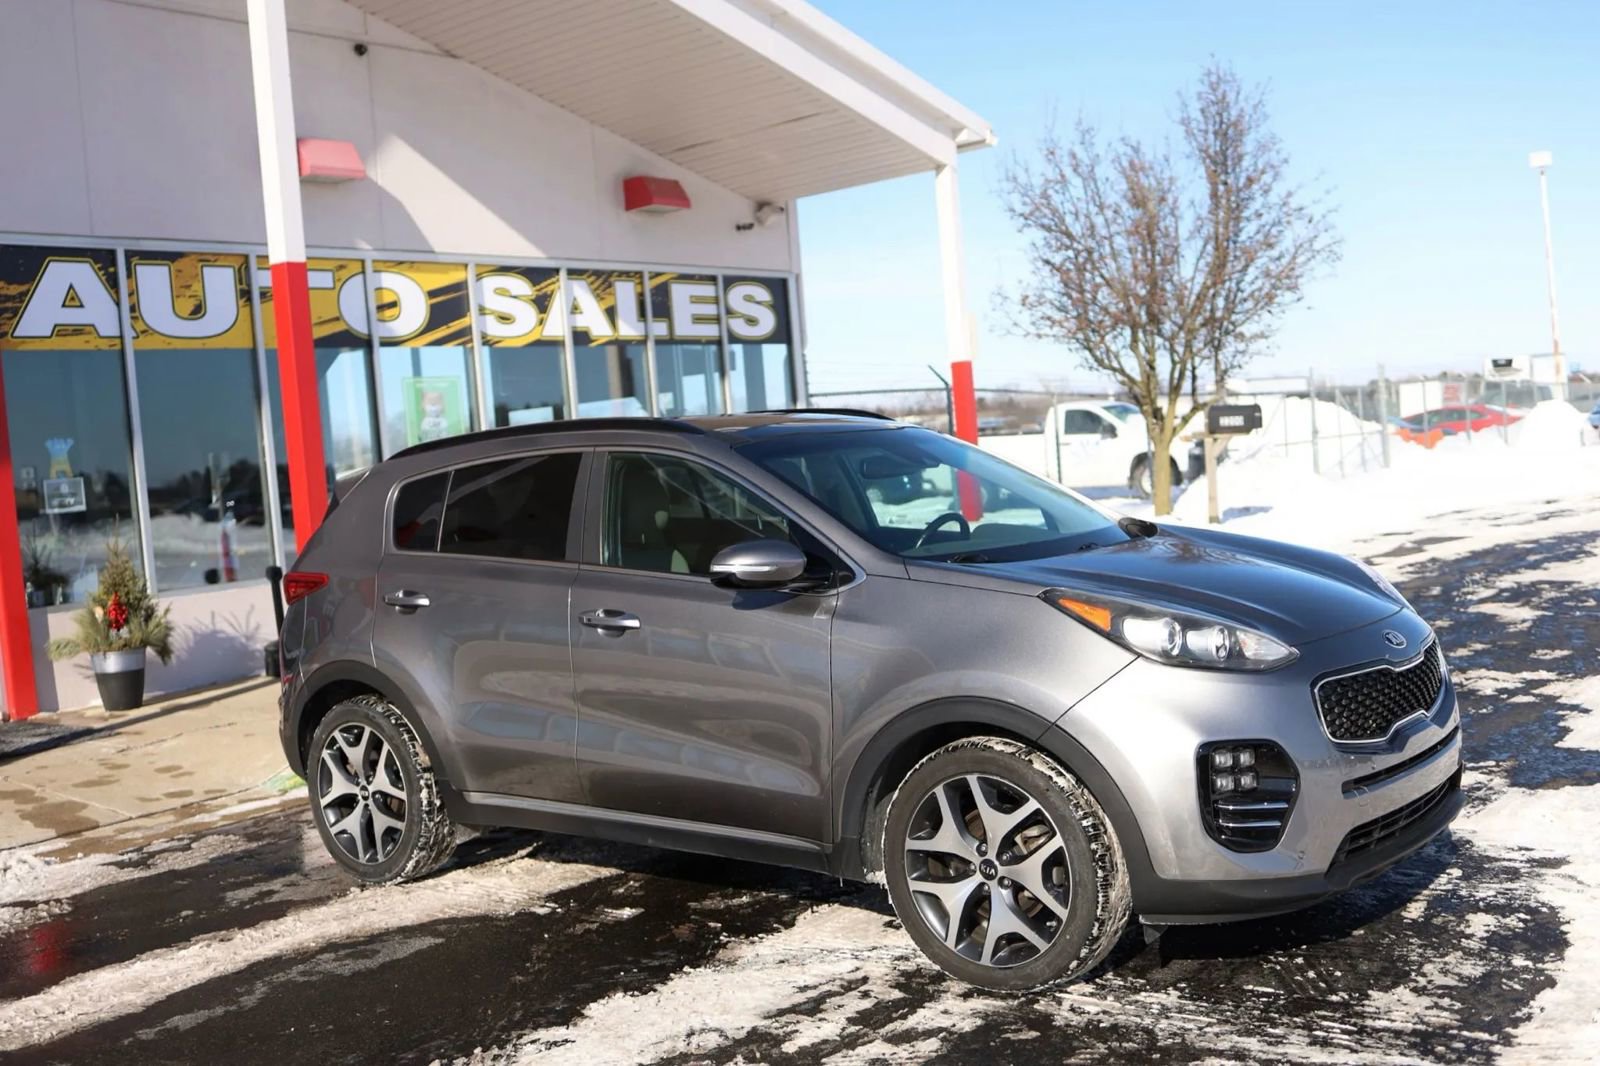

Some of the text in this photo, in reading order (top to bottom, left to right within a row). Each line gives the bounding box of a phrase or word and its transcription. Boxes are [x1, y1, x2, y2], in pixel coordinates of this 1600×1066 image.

[10, 257, 777, 342] AUO SALES
[980, 863, 996, 876] KIA
